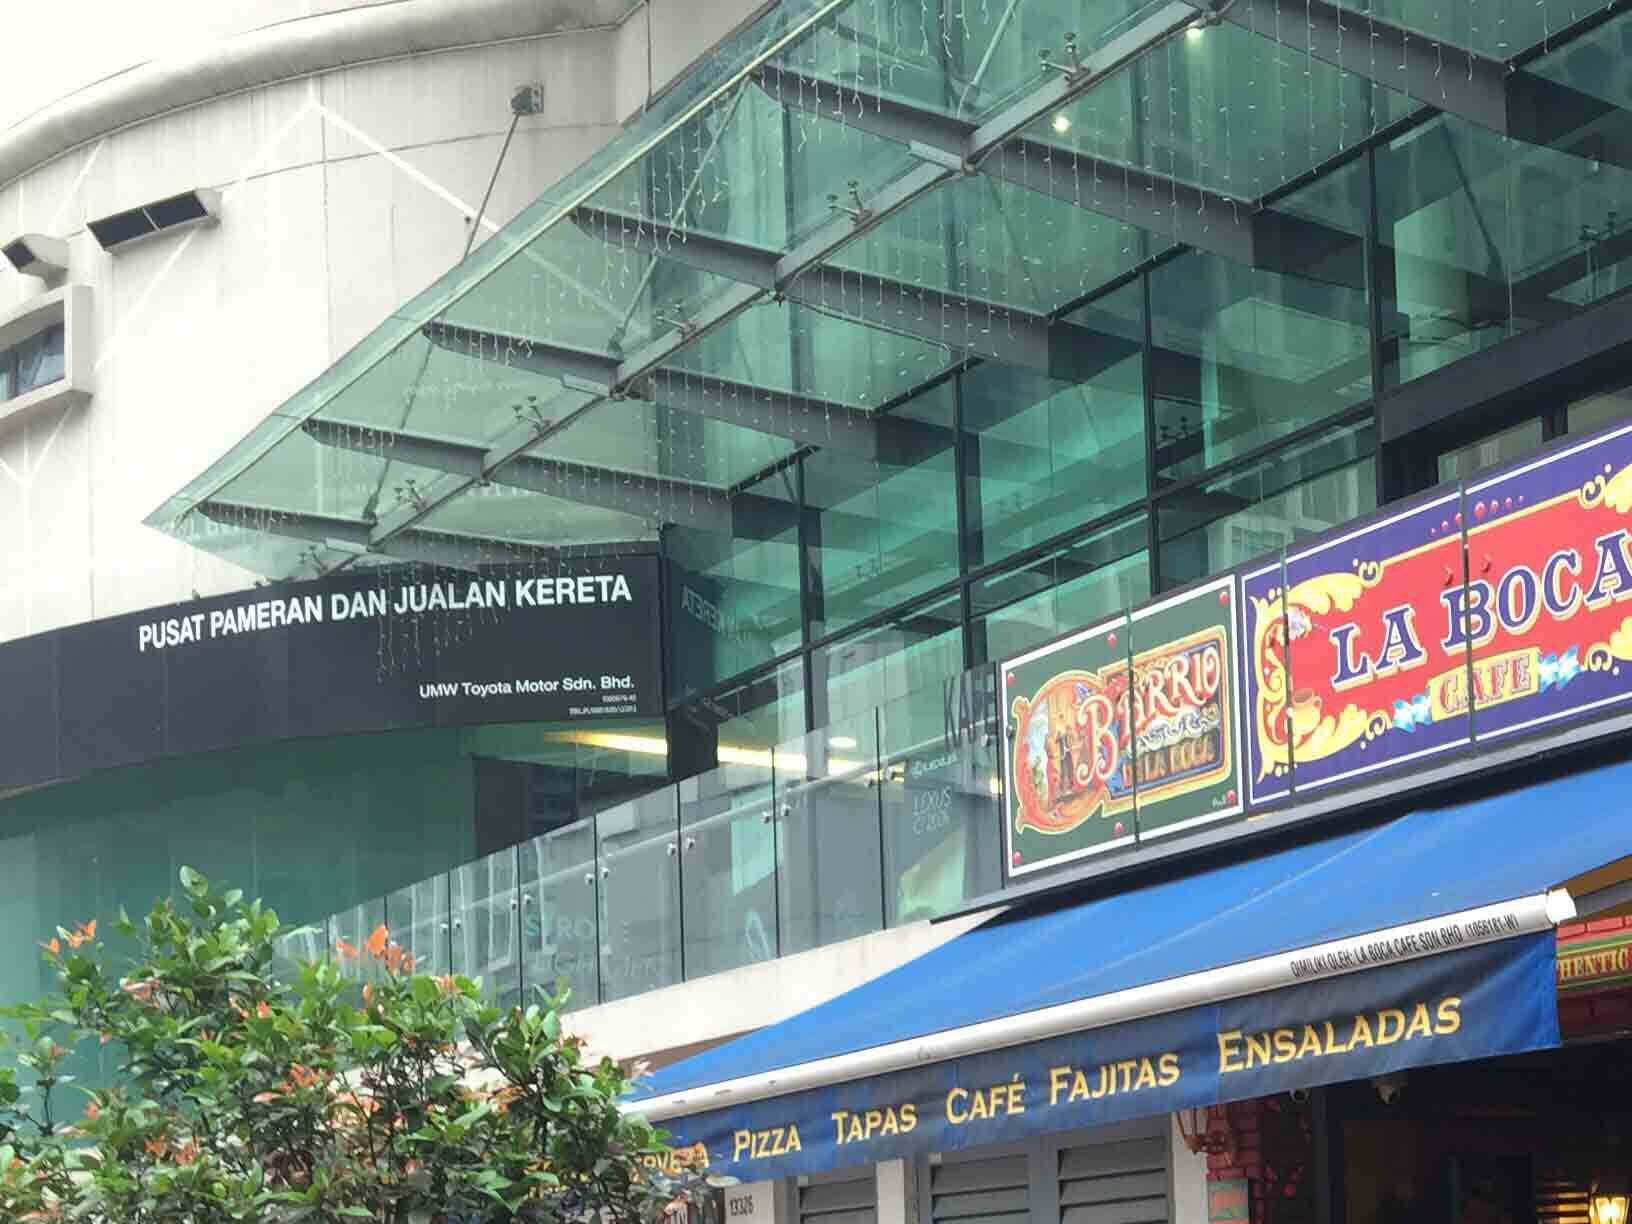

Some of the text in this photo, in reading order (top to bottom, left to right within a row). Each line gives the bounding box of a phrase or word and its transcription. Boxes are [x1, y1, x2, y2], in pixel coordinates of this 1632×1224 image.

[139, 575, 633, 651] PUSAT PAMERAN DAN JUALAN KERETA
[1328, 604, 1427, 692] LA
[419, 675, 635, 699] UMW Toyota Motor Sdn. Bhd.
[1075, 646, 1220, 785] BARRIO
[1440, 653, 1531, 714] CAFE
[1394, 934, 1420, 957] CAFE
[1558, 947, 1630, 982] HENTIC
[733, 1124, 802, 1163] PIZZA
[831, 1103, 918, 1146] TAPAS
[945, 1073, 1026, 1125] CAFÉ
[1049, 1052, 1182, 1105] FAJITAS
[1217, 997, 1463, 1073] ENSALADAS
